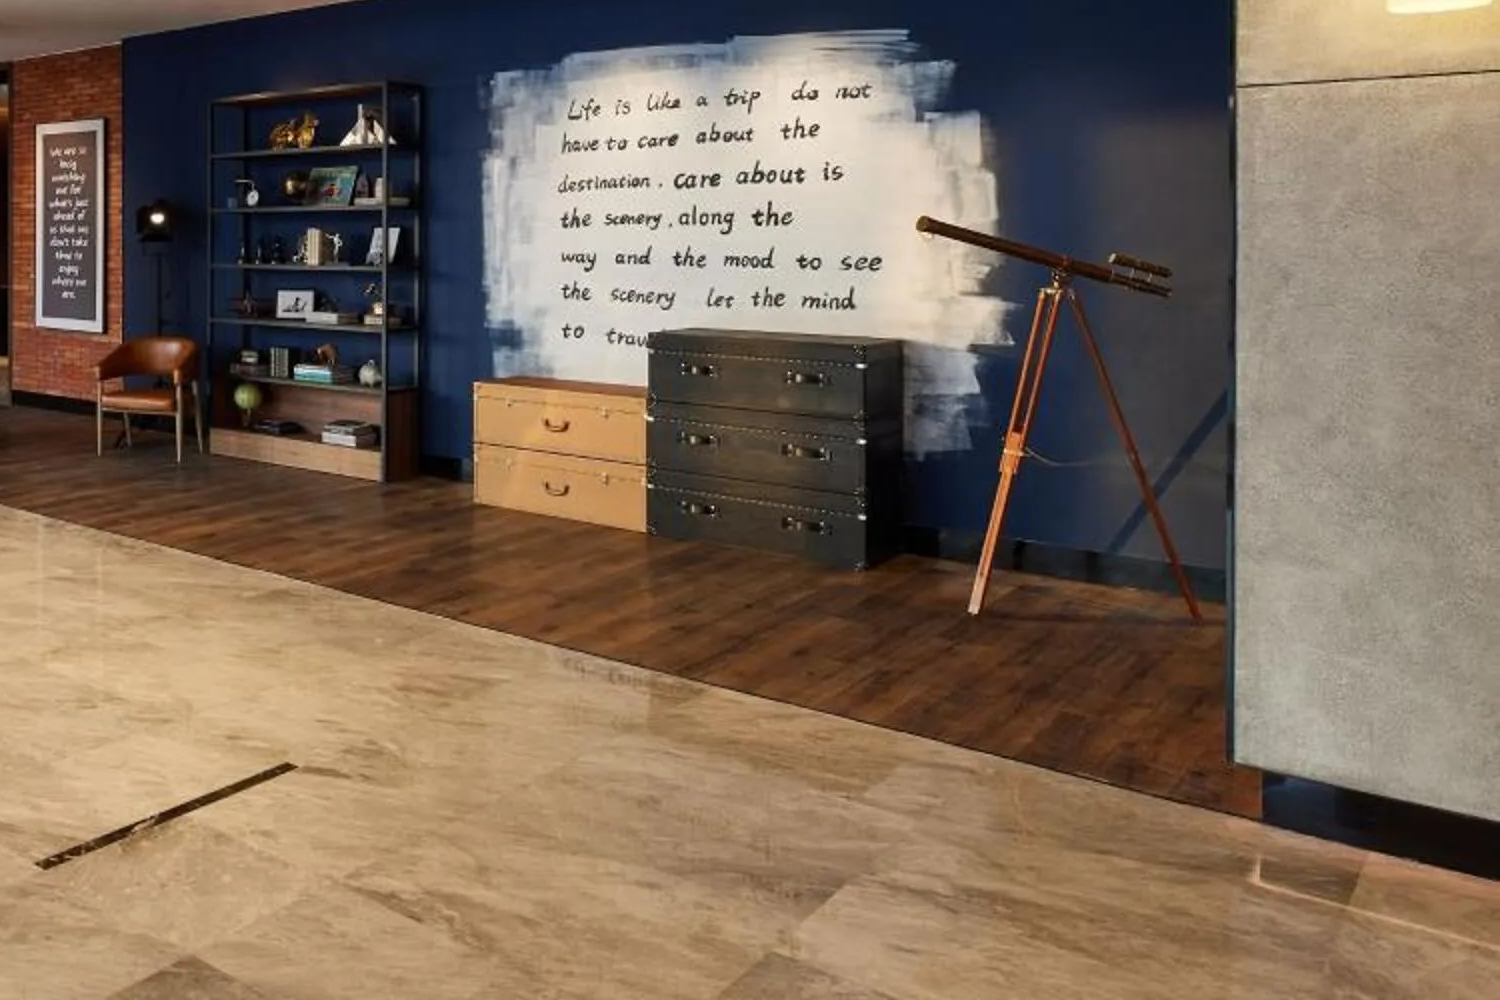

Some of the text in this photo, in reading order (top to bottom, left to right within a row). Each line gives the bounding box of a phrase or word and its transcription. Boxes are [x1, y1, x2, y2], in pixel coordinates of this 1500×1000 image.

[568, 80, 872, 121] Life is like a trip do not
[562, 116, 820, 154] have to care about the
[674, 172, 721, 189] care
[736, 160, 805, 185] about
[822, 161, 844, 182] is
[560, 207, 592, 229] the
[679, 204, 735, 235] along
[751, 201, 794, 227] the
[561, 246, 883, 272] way and the mood to see
[561, 280, 857, 310] the scenery let the mind
[561, 323, 585, 339] to
